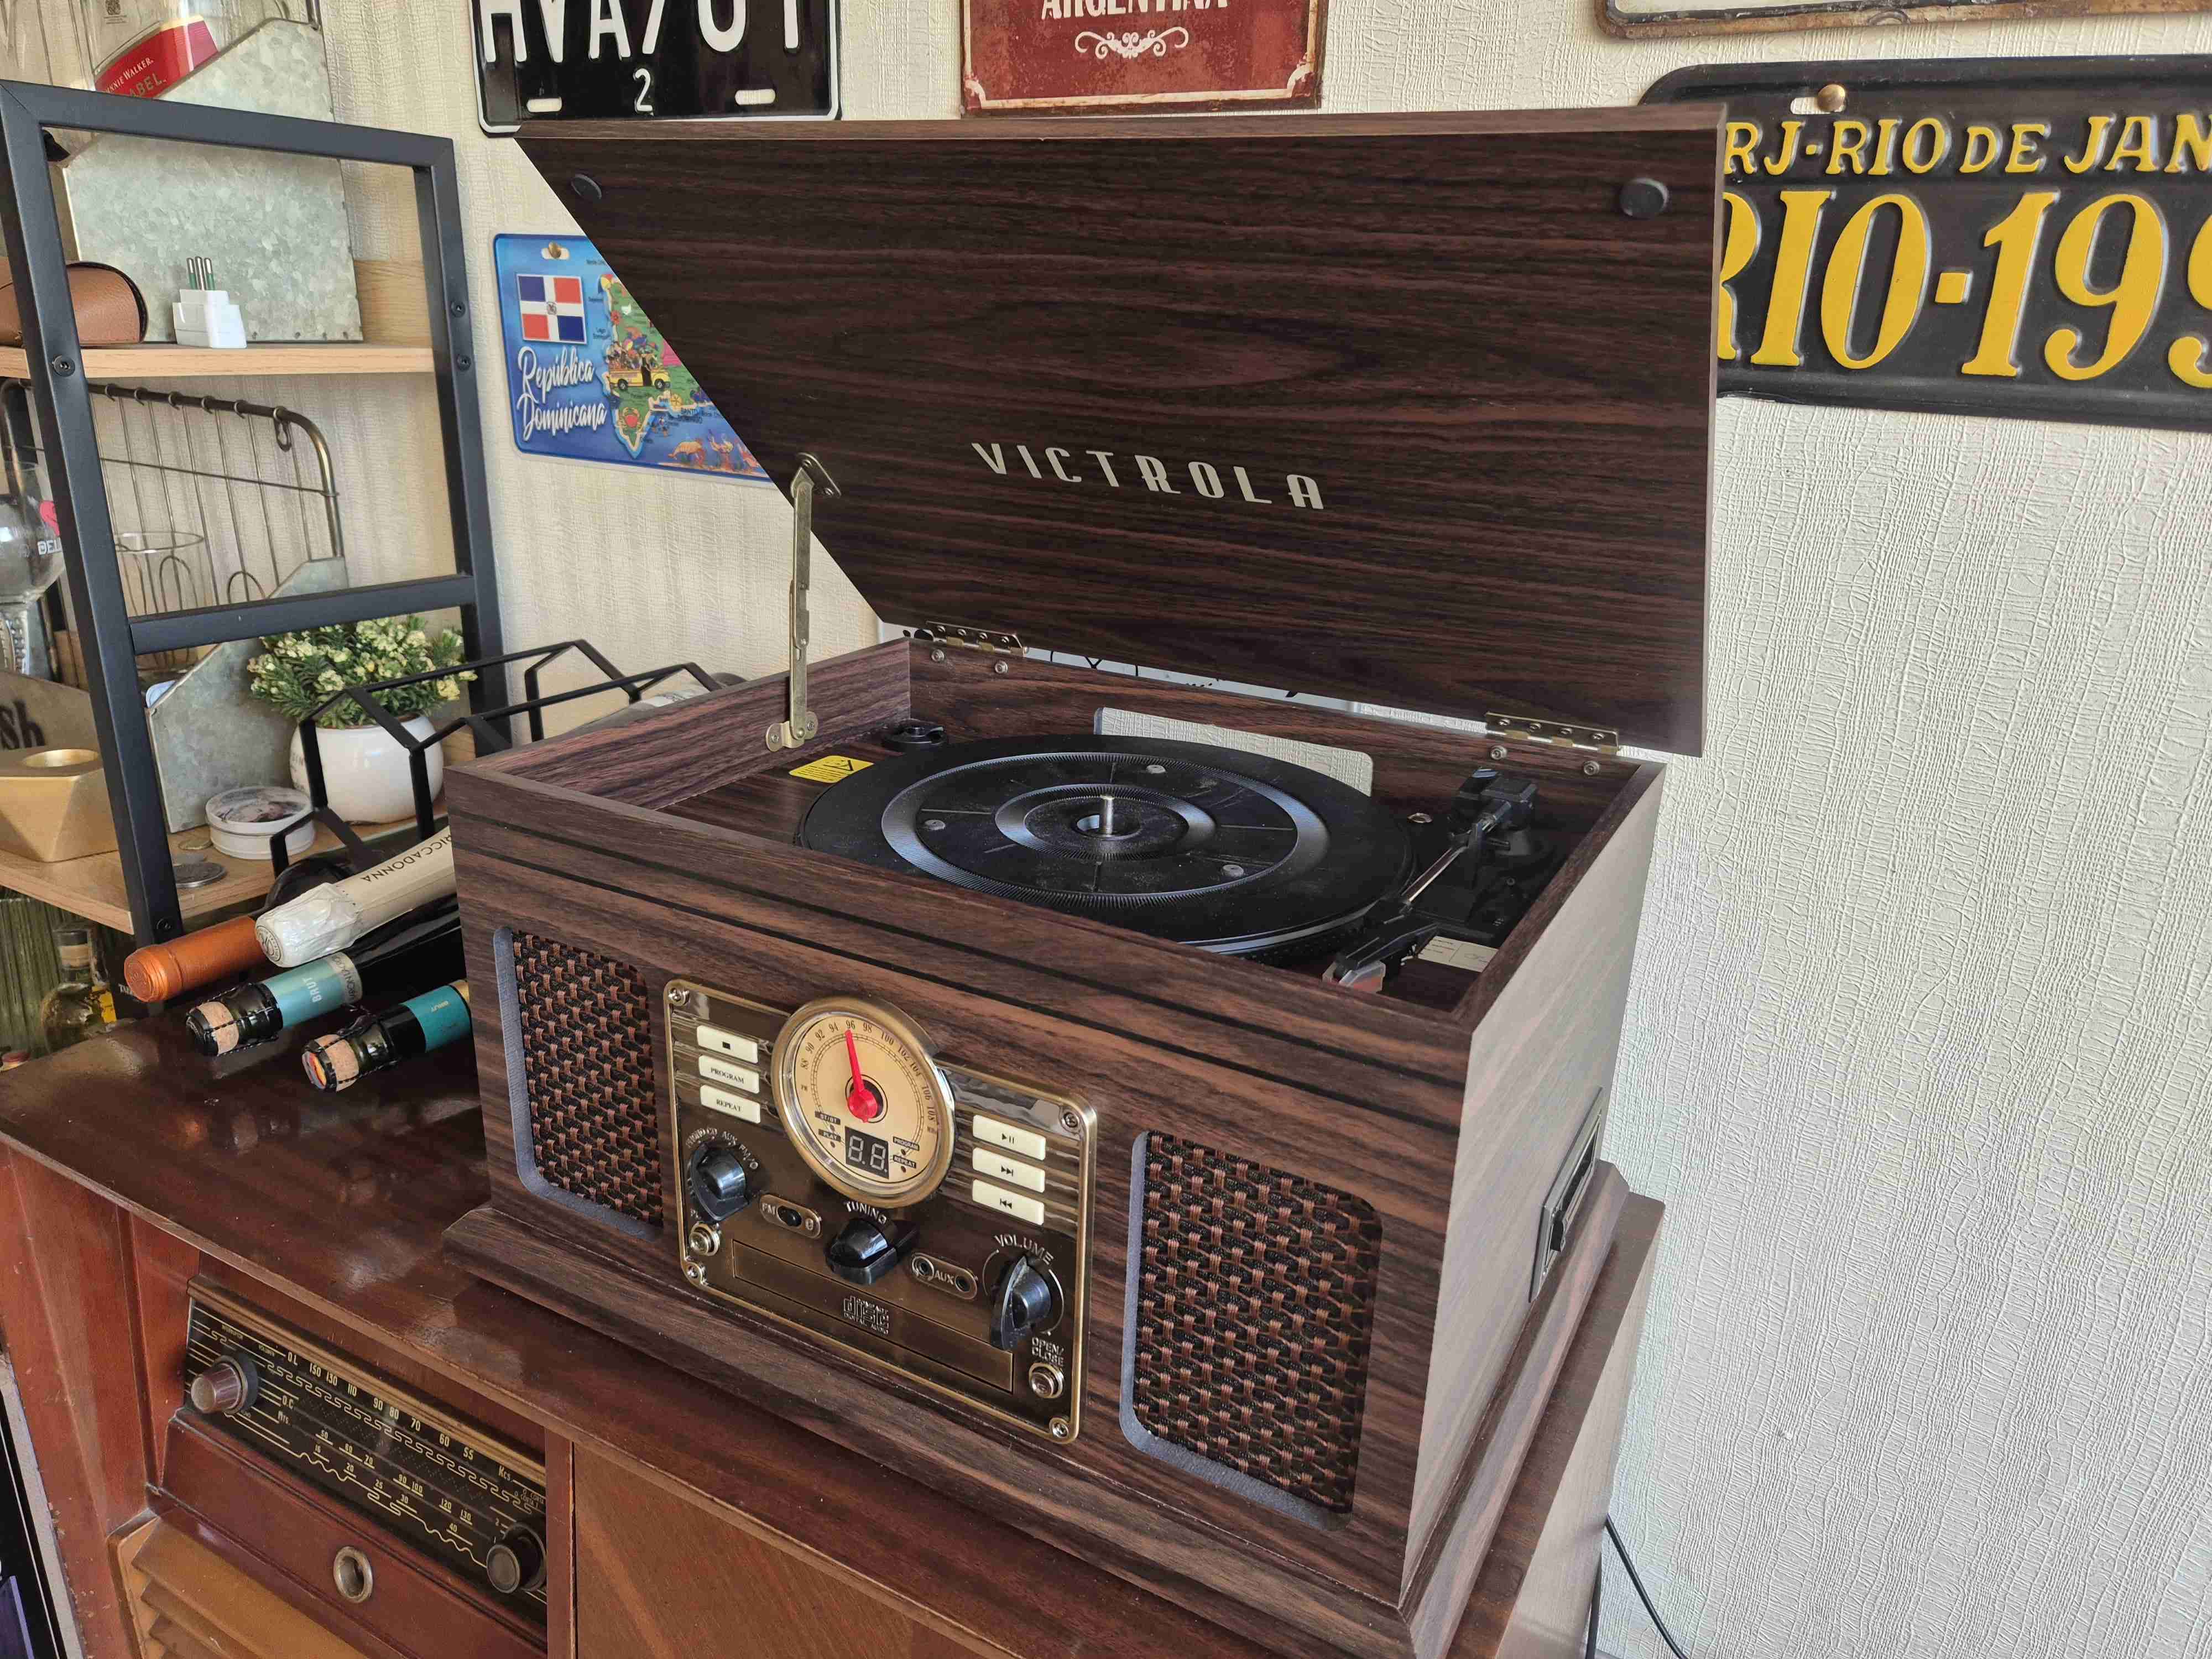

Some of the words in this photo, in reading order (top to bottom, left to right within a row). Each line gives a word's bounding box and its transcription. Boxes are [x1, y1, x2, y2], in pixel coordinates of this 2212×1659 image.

[633, 68, 653, 111] 2
[1960, 122, 2046, 174] DE
[518, 346, 595, 405] República
[516, 393, 608, 442] Dominicana
[971, 442, 1324, 509] VICTROLA
[302, 977, 322, 1003] BRUT
[828, 1022, 839, 1032] 94
[846, 1020, 855, 1030] 96
[863, 1023, 873, 1033] 98
[815, 1029, 826, 1041] 92
[880, 1031, 894, 1046] 100
[805, 1042, 815, 1055] 90
[897, 1046, 911, 1062] 102
[800, 1057, 810, 1070] 88
[711, 1067, 744, 1084] PROGRAM
[921, 1086, 932, 1101] 106
[716, 1099, 743, 1112] REPEAT
[927, 1106, 936, 1122] 108
[722, 1130, 737, 1146] AUX
[894, 1138, 919, 1150] PROGRAM
[894, 1156, 915, 1168] REPEAT
[844, 1201, 887, 1225] TUNING
[994, 1234, 1055, 1266] VOLUME
[935, 1270, 956, 1285] AUX
[1031, 1337, 1065, 1355] OPEN/
[1031, 1347, 1064, 1366] CLOSE
[309, 1362, 322, 1378] 150
[326, 1371, 338, 1386] 130
[347, 1383, 357, 1397] 110
[373, 1397, 384, 1411] 90
[389, 1406, 399, 1420] 80
[411, 1417, 421, 1432] 70
[439, 1433, 450, 1447] 60
[463, 1446, 474, 1460] 55
[321, 1430, 328, 1439] 50
[365, 1454, 373, 1465] 70
[398, 1473, 407, 1484] 90
[411, 1481, 423, 1493] 100
[441, 1498, 452, 1510] 120
[461, 1509, 472, 1521] 130
[346, 1462, 354, 1473] 20
[375, 1479, 383, 1490] 25
[400, 1494, 409, 1504] 30
[449, 1522, 457, 1533] 40
